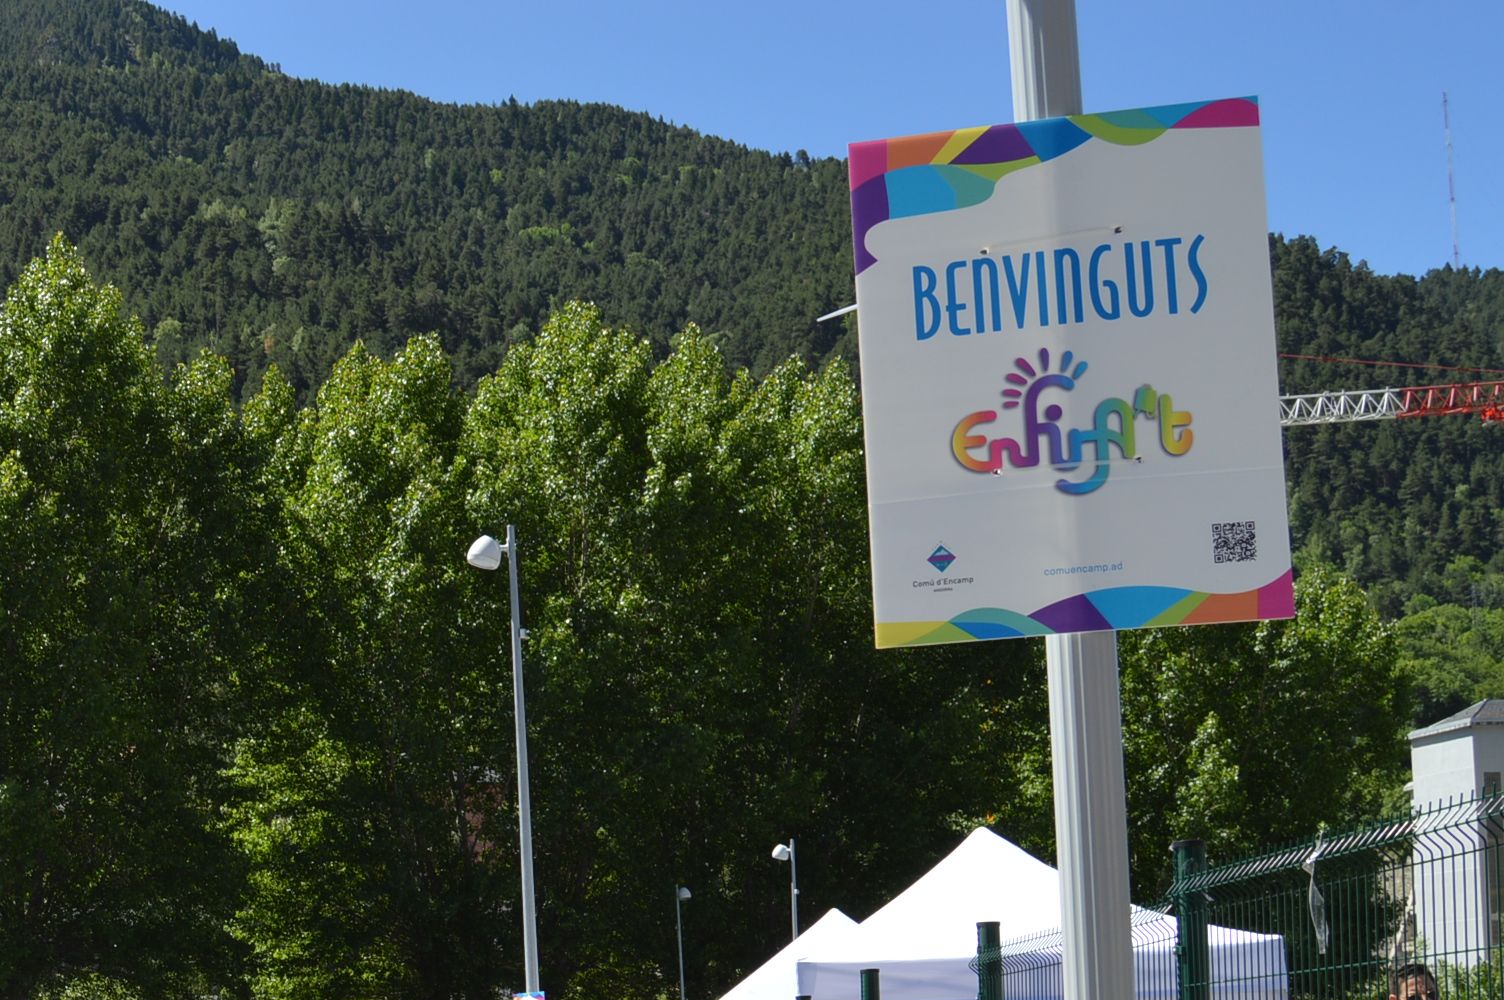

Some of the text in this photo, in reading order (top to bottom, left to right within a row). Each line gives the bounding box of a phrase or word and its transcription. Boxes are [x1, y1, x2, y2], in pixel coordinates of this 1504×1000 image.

[912, 234, 1208, 341] BENVINGUTS
[1043, 562, 1124, 577] comuencamp.ad
[912, 579, 935, 588] Comú
